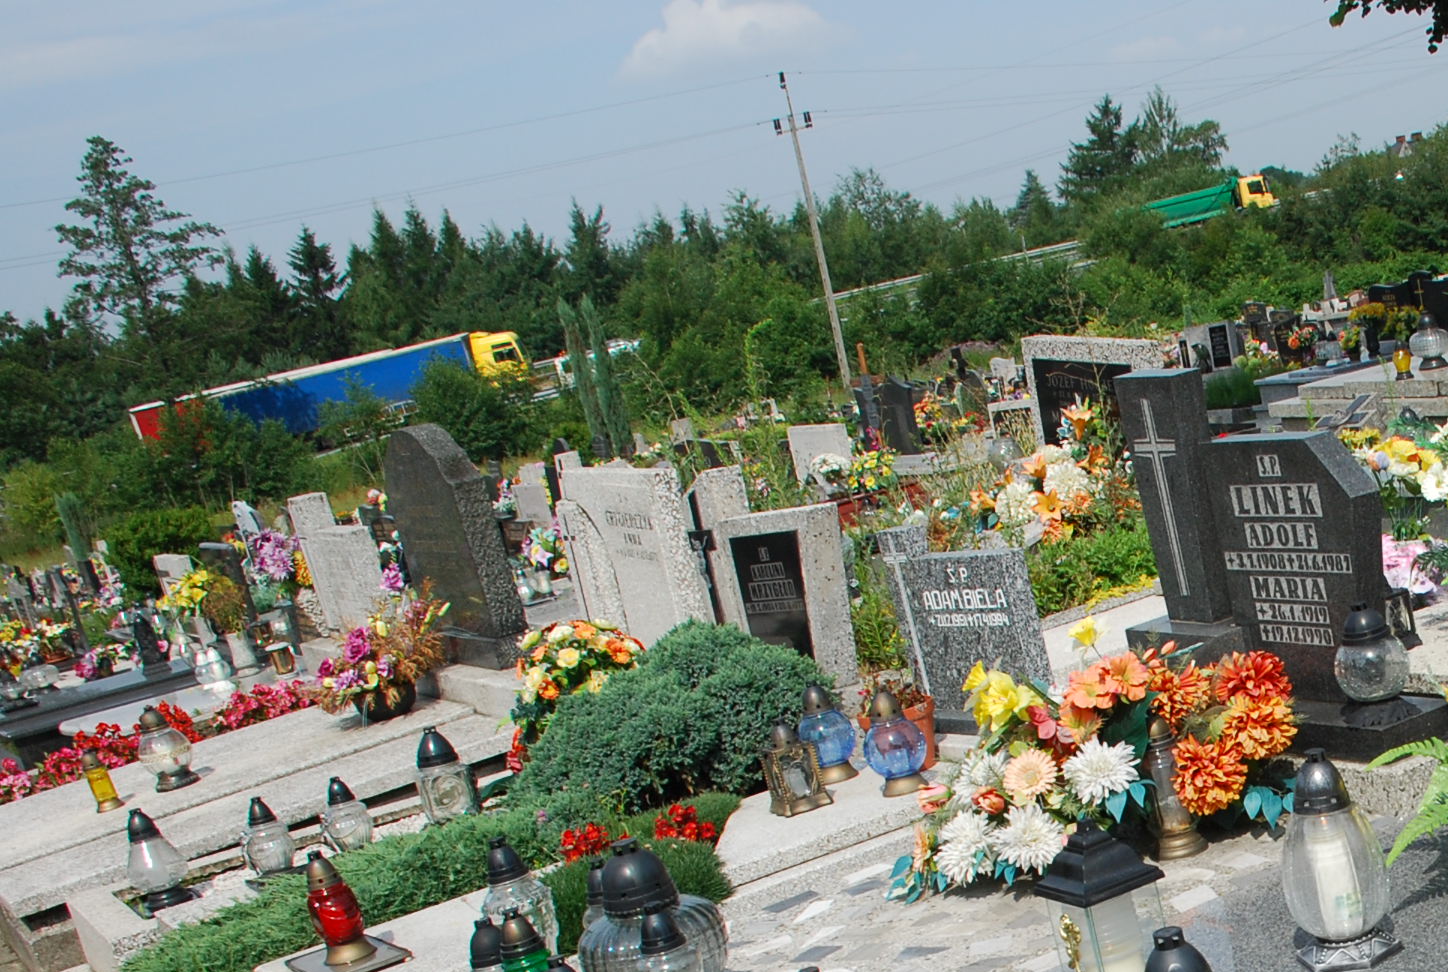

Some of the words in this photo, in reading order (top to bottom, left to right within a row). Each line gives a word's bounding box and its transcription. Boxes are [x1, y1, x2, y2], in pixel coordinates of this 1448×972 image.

[1234, 485, 1319, 516] LINEK
[1248, 523, 1315, 548] ADOLF
[923, 589, 963, 610] ADAM
[962, 588, 1008, 609] BIELA
[1253, 577, 1326, 600] MARIA
